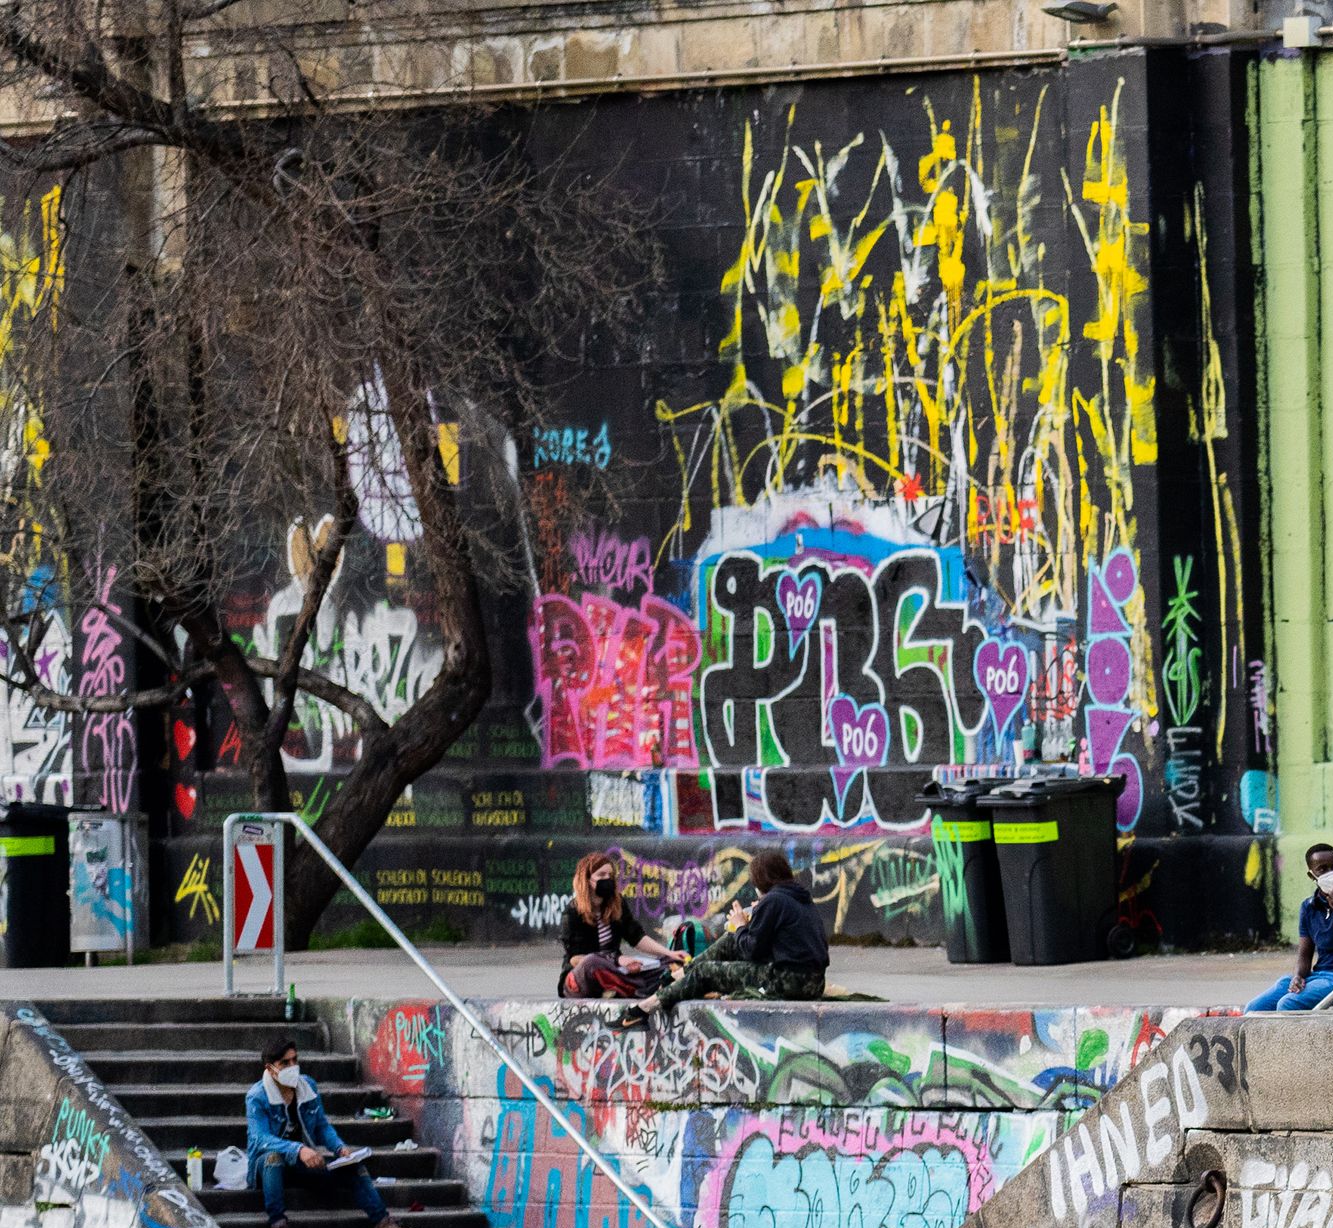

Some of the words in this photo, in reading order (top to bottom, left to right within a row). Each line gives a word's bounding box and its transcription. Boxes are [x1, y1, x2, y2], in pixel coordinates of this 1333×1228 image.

[786, 590, 815, 618] PO6
[985, 655, 1019, 694] PO6
[842, 725, 879, 757] PO6
